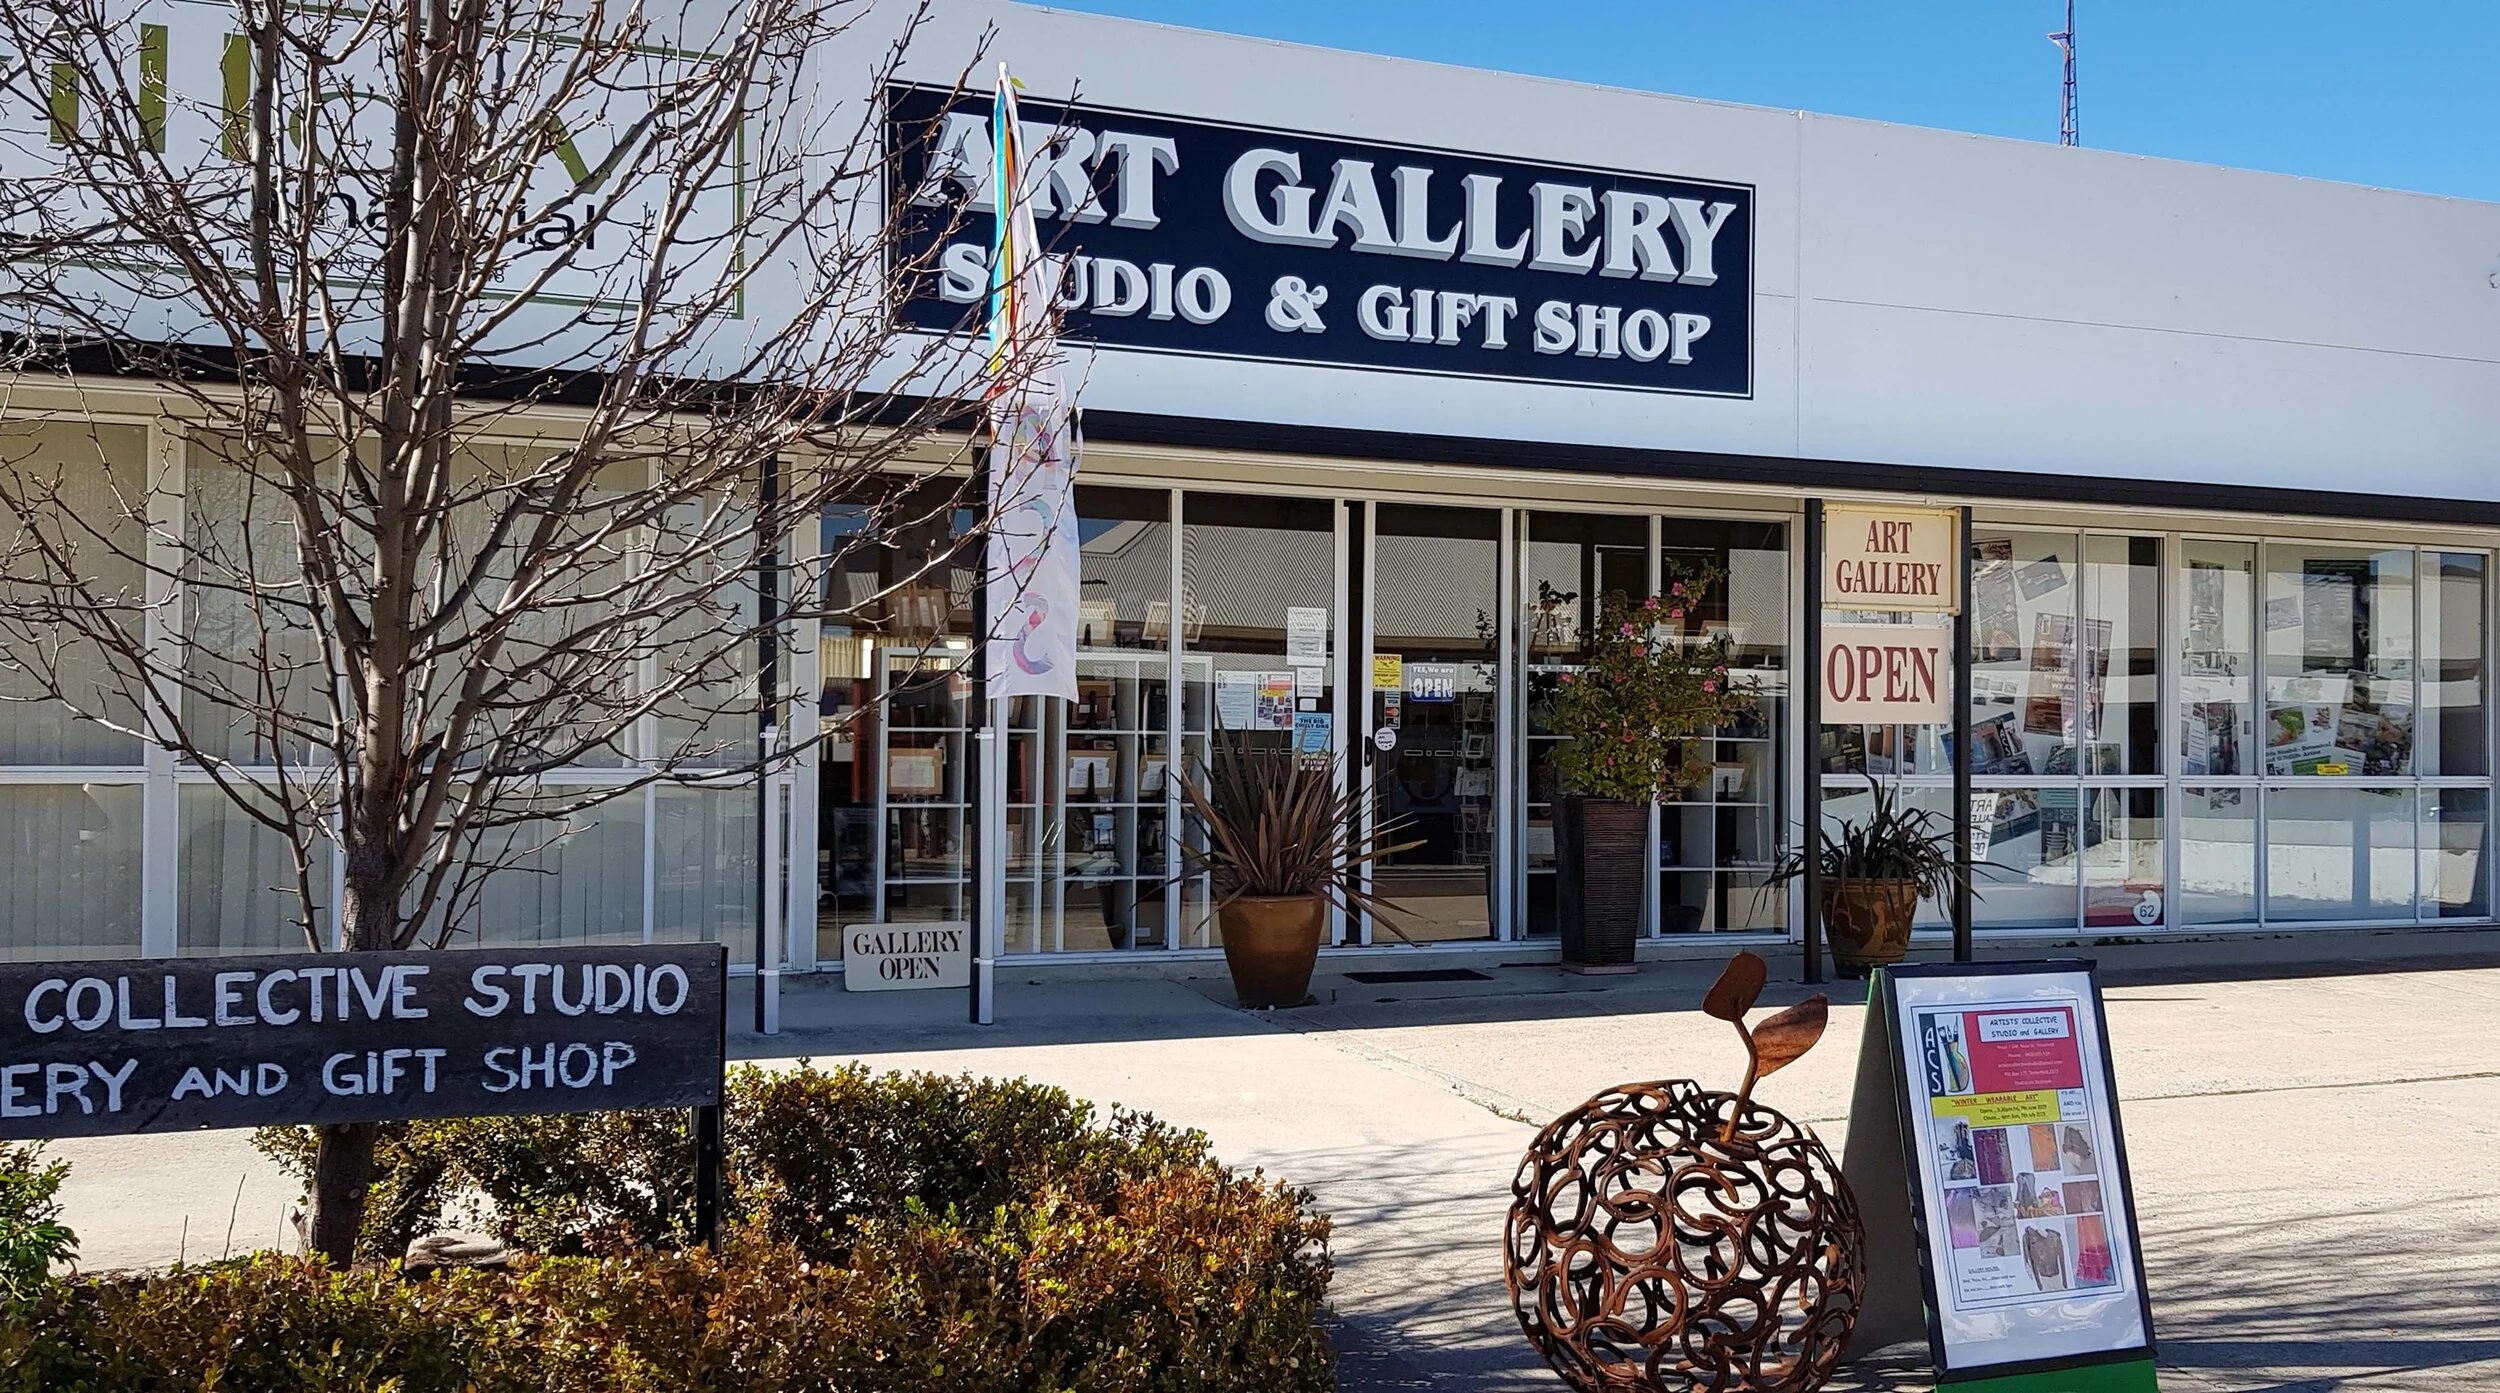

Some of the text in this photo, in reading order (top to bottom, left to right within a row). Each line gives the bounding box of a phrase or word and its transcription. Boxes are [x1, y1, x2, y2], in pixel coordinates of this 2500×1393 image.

[909, 112, 1736, 286] ART GALLERY
[939, 243, 1711, 365] SUDIO & GIFT SHOP
[1865, 519, 1913, 554] ART
[1836, 559, 1941, 596] GALLERY
[1413, 677, 1453, 698] OPEN
[1827, 643, 1938, 704] OPEN
[2139, 905, 2155, 918] 62
[853, 930, 962, 955] GALLERY
[879, 956, 940, 980] OPEN
[24, 963, 690, 1033] COLLECTIVE STUDIO
[1991, 1029, 2017, 1038] STUDIO
[2034, 1028, 2059, 1036] GALLERY
[2021, 1016, 2058, 1024] COLLECTIVE
[171, 1063, 289, 1100] AND
[481, 1041, 637, 1093] SHOP
[1985, 1096, 2017, 1104] WEARABLE
